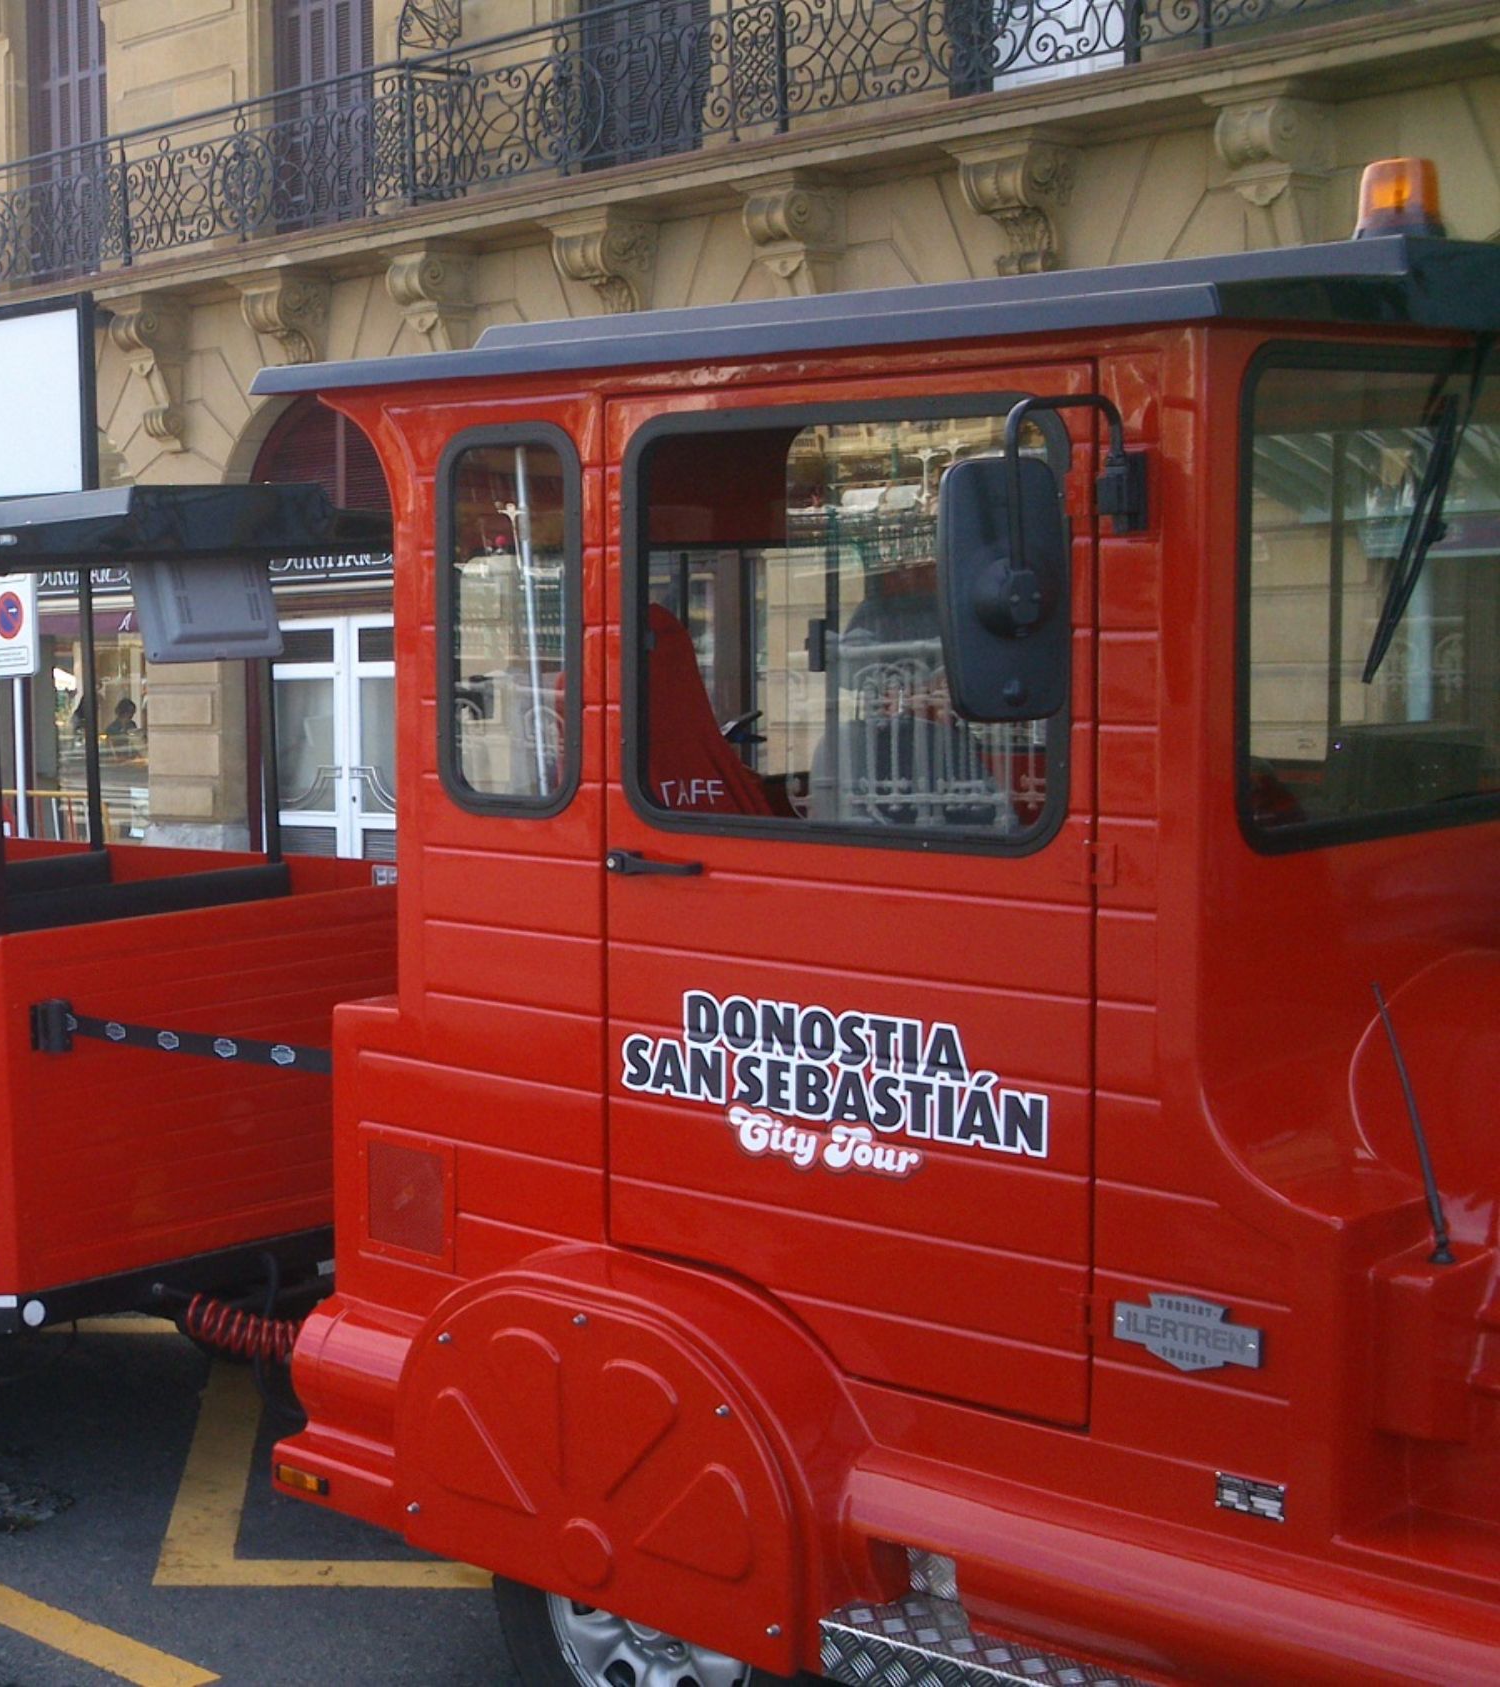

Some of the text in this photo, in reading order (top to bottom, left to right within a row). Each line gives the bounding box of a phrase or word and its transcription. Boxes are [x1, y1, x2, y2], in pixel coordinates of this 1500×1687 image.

[660, 779, 725, 808] TAFF
[685, 991, 968, 1085] DONOSTIA
[623, 1035, 1048, 1157] SAN SEBASTIÁN
[729, 1106, 921, 1173] City Tour
[1125, 1310, 1248, 1355] ILERTREN
